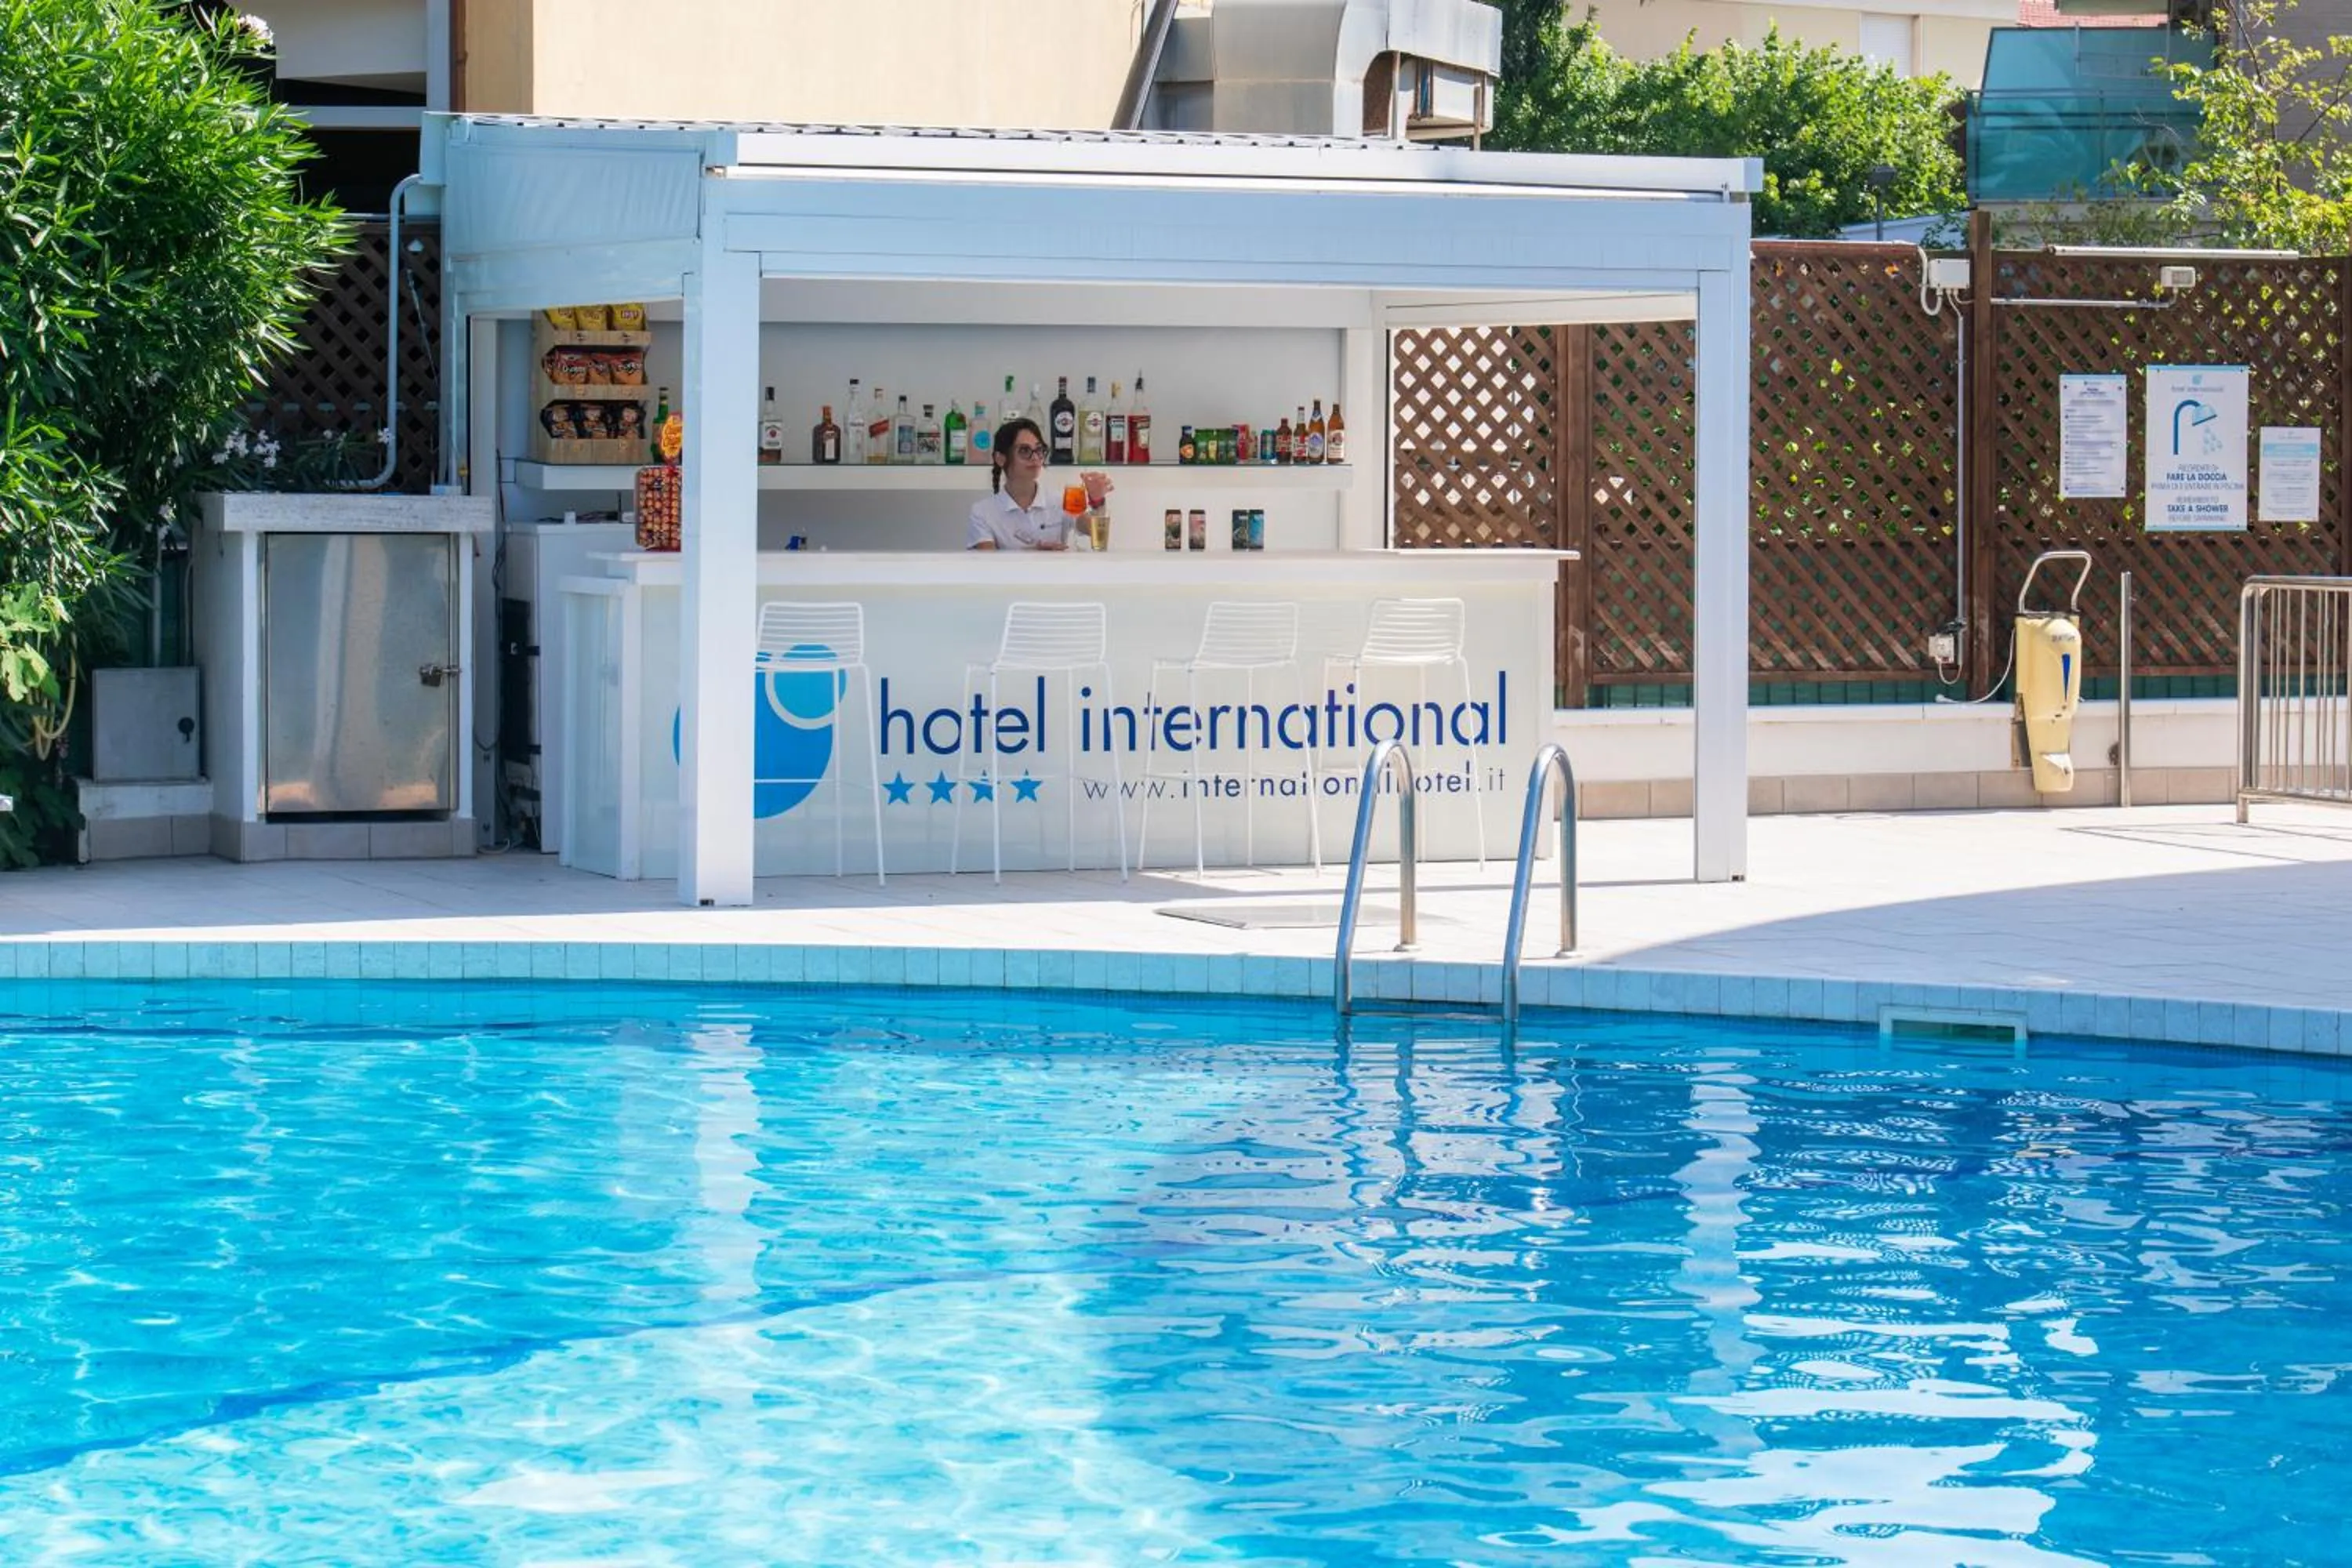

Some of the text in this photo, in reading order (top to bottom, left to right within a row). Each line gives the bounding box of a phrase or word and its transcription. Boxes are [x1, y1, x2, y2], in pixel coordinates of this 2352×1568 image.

[2166, 472, 2227, 481] FARE LA DOCCIA
[2167, 504, 2186, 513] TAKE
[2195, 504, 2229, 513] SHOWER
[880, 670, 1506, 756] hotel international
